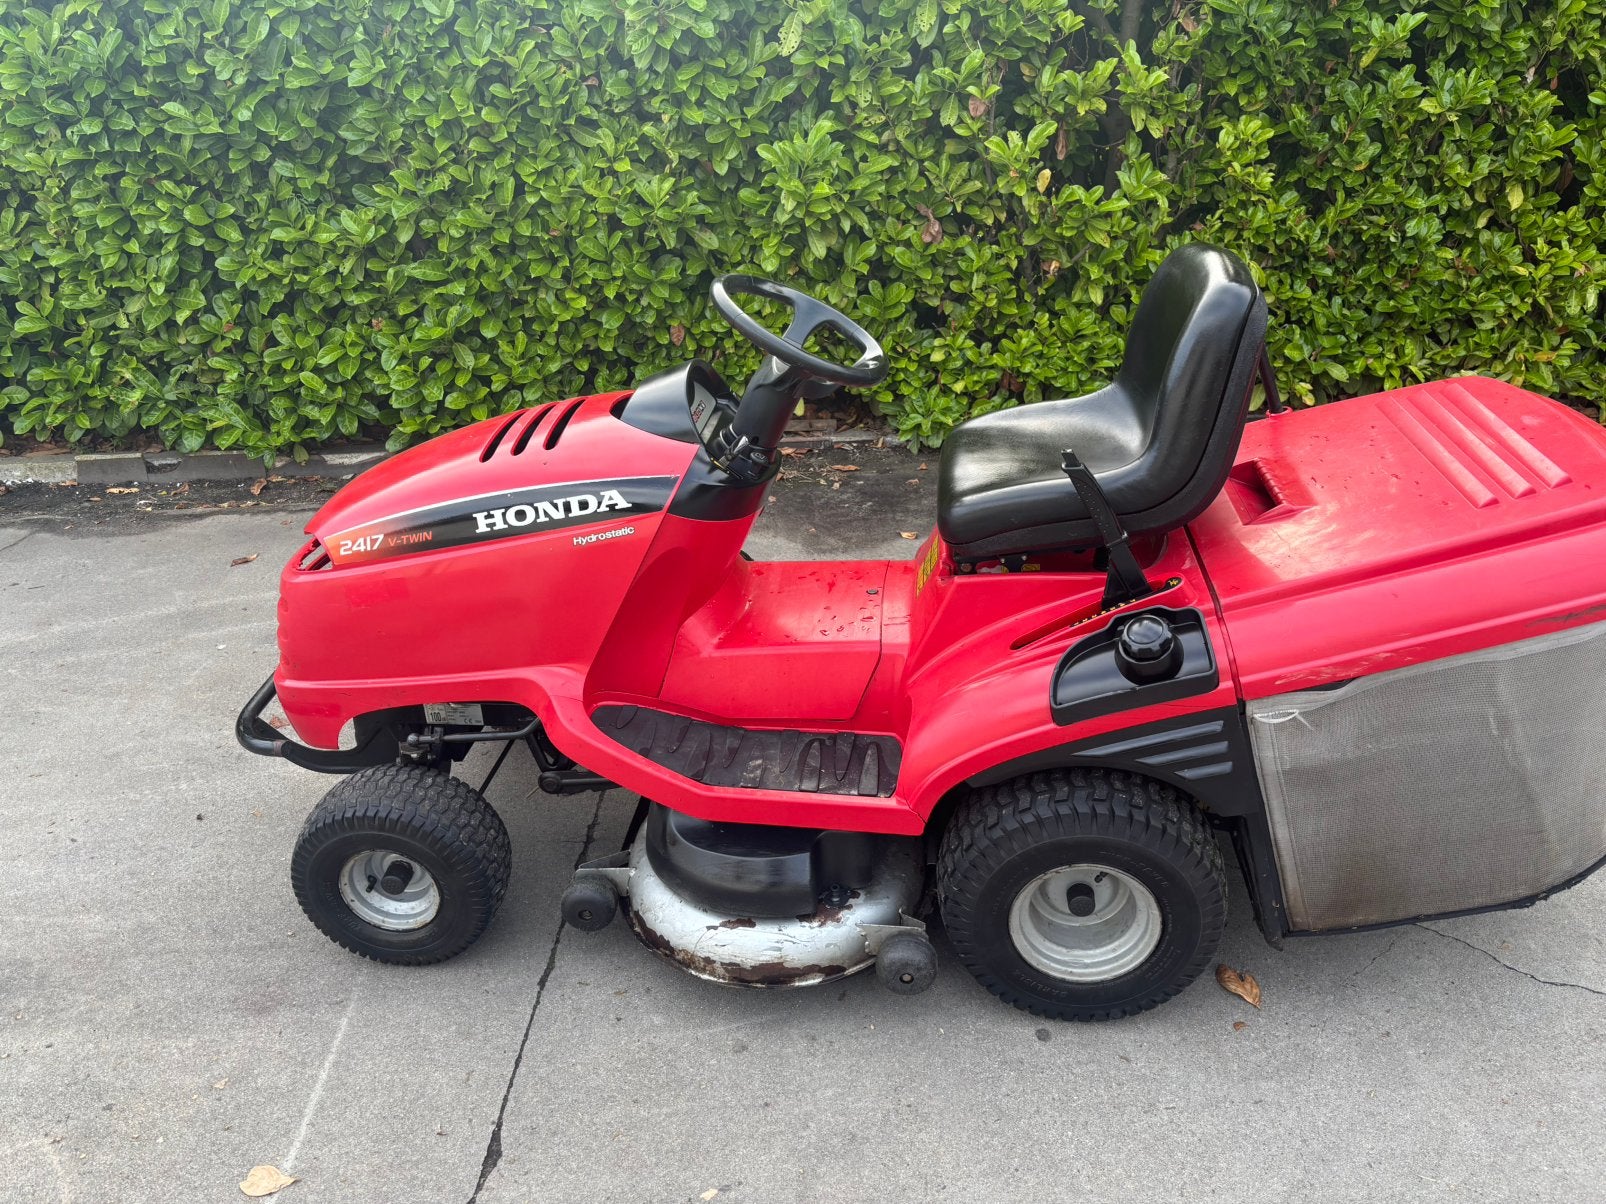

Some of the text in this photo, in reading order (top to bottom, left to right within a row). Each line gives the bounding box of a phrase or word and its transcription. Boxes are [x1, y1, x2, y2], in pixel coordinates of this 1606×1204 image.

[472, 489, 632, 534] HONDA
[340, 531, 433, 556] 2417 V-TWIN
[573, 526, 635, 546] Hydrostatic
